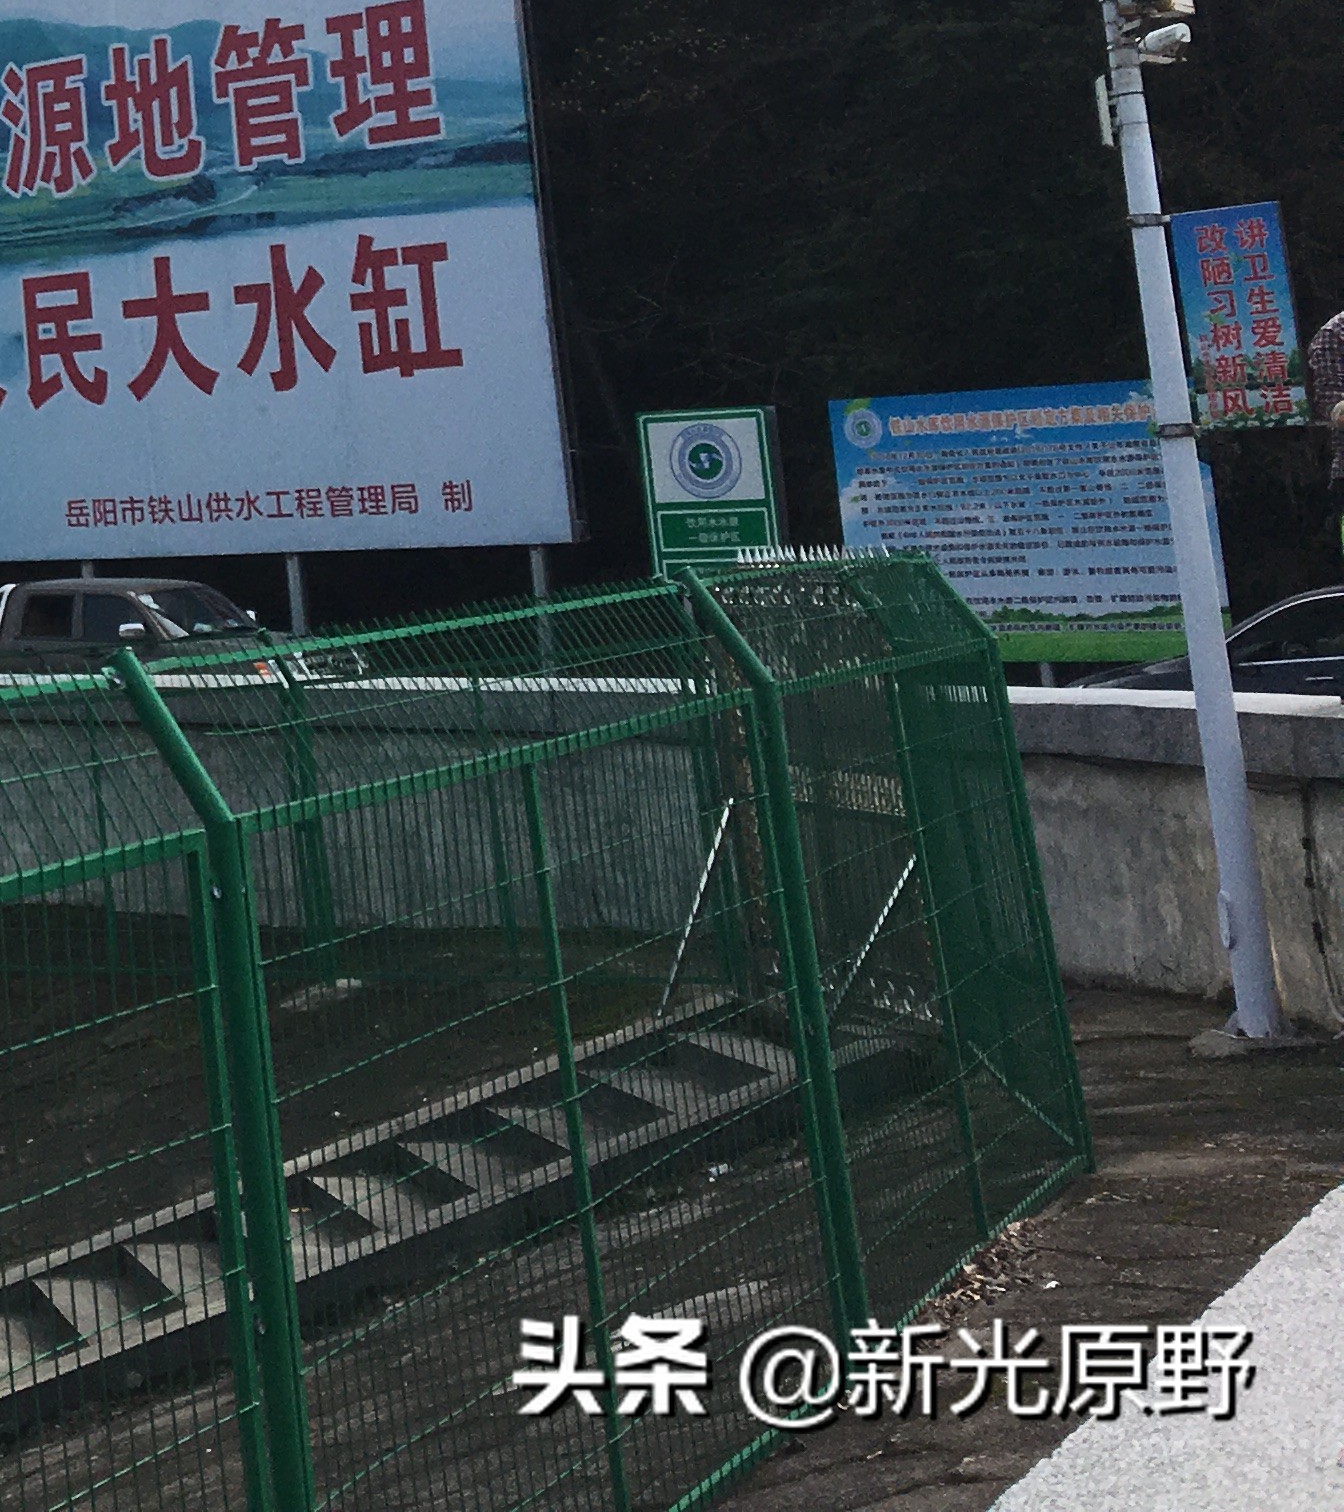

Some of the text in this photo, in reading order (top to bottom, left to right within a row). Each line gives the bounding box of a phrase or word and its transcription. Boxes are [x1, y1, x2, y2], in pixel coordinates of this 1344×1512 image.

[1195, 222, 1255, 417] 改陋习树新风
[1234, 217, 1295, 414] 讲卫生爱清洁
[64, 478, 474, 530] 岳阳市铁山供水工程管理局 制
